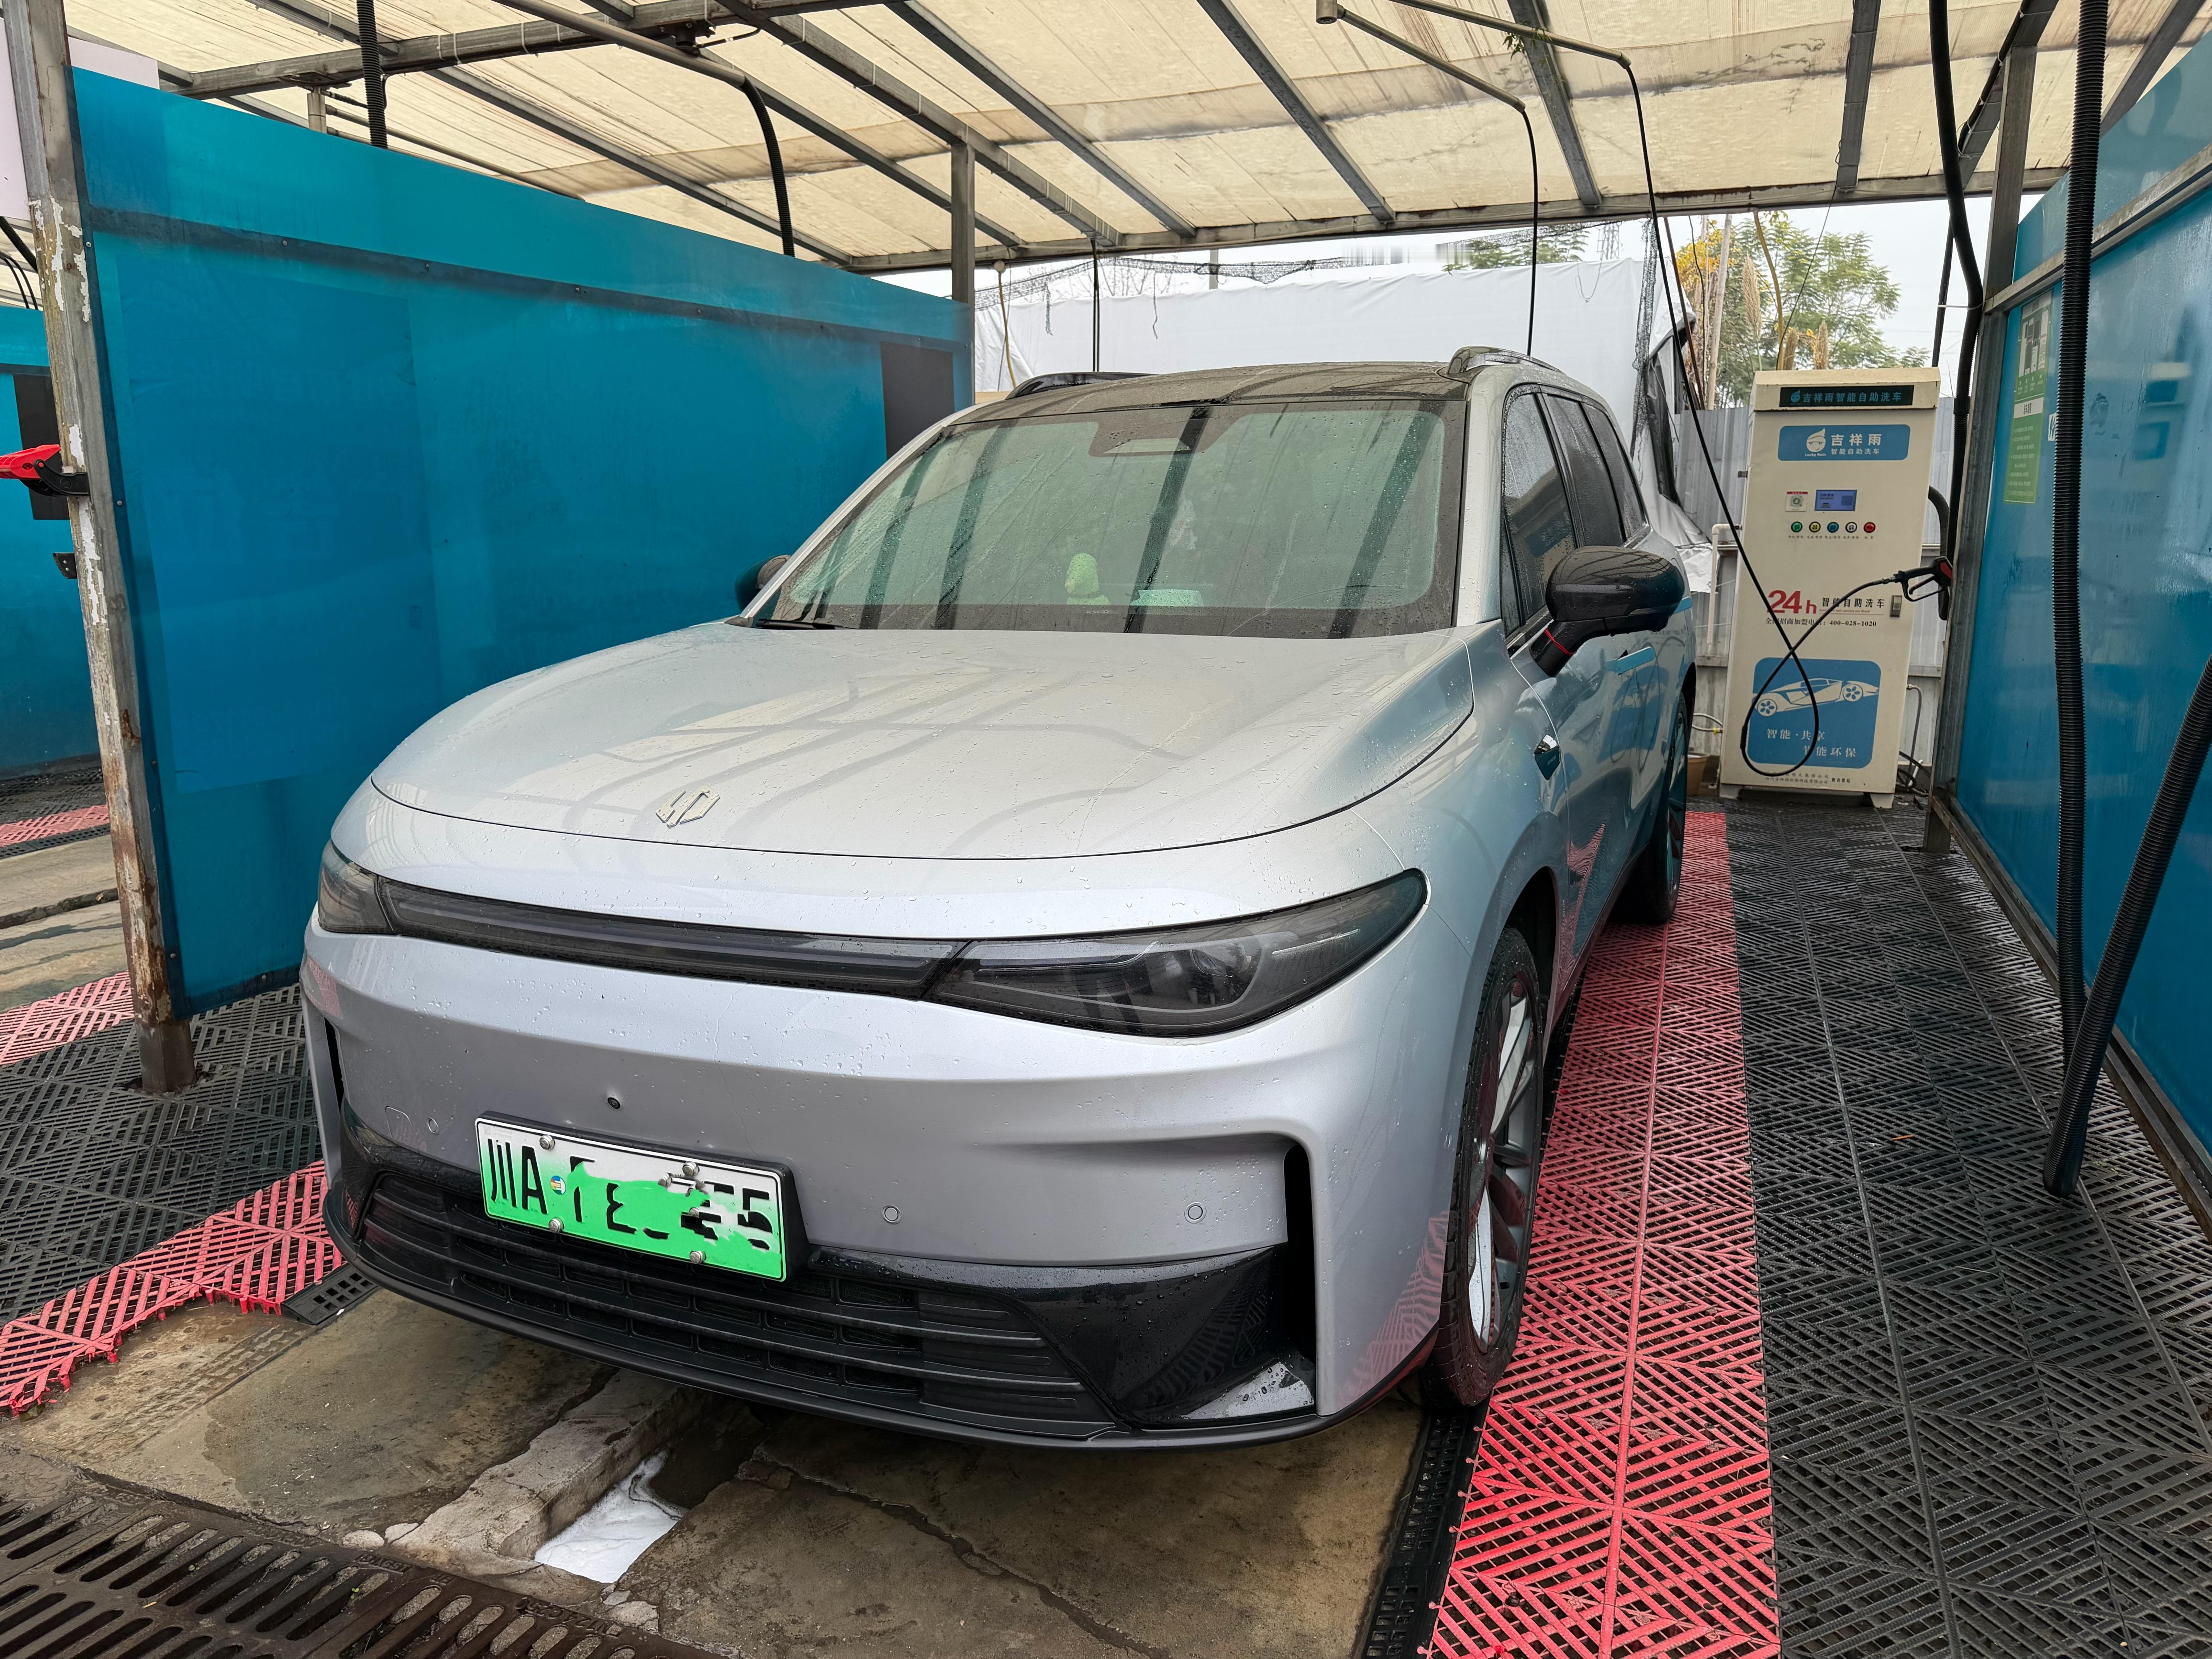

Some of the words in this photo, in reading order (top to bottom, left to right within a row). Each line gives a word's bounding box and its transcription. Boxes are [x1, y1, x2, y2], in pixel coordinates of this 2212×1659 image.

[1803, 392, 1902, 403] 吉祥雨智能自助洗车
[1831, 433, 1882, 446] 吉祥雨
